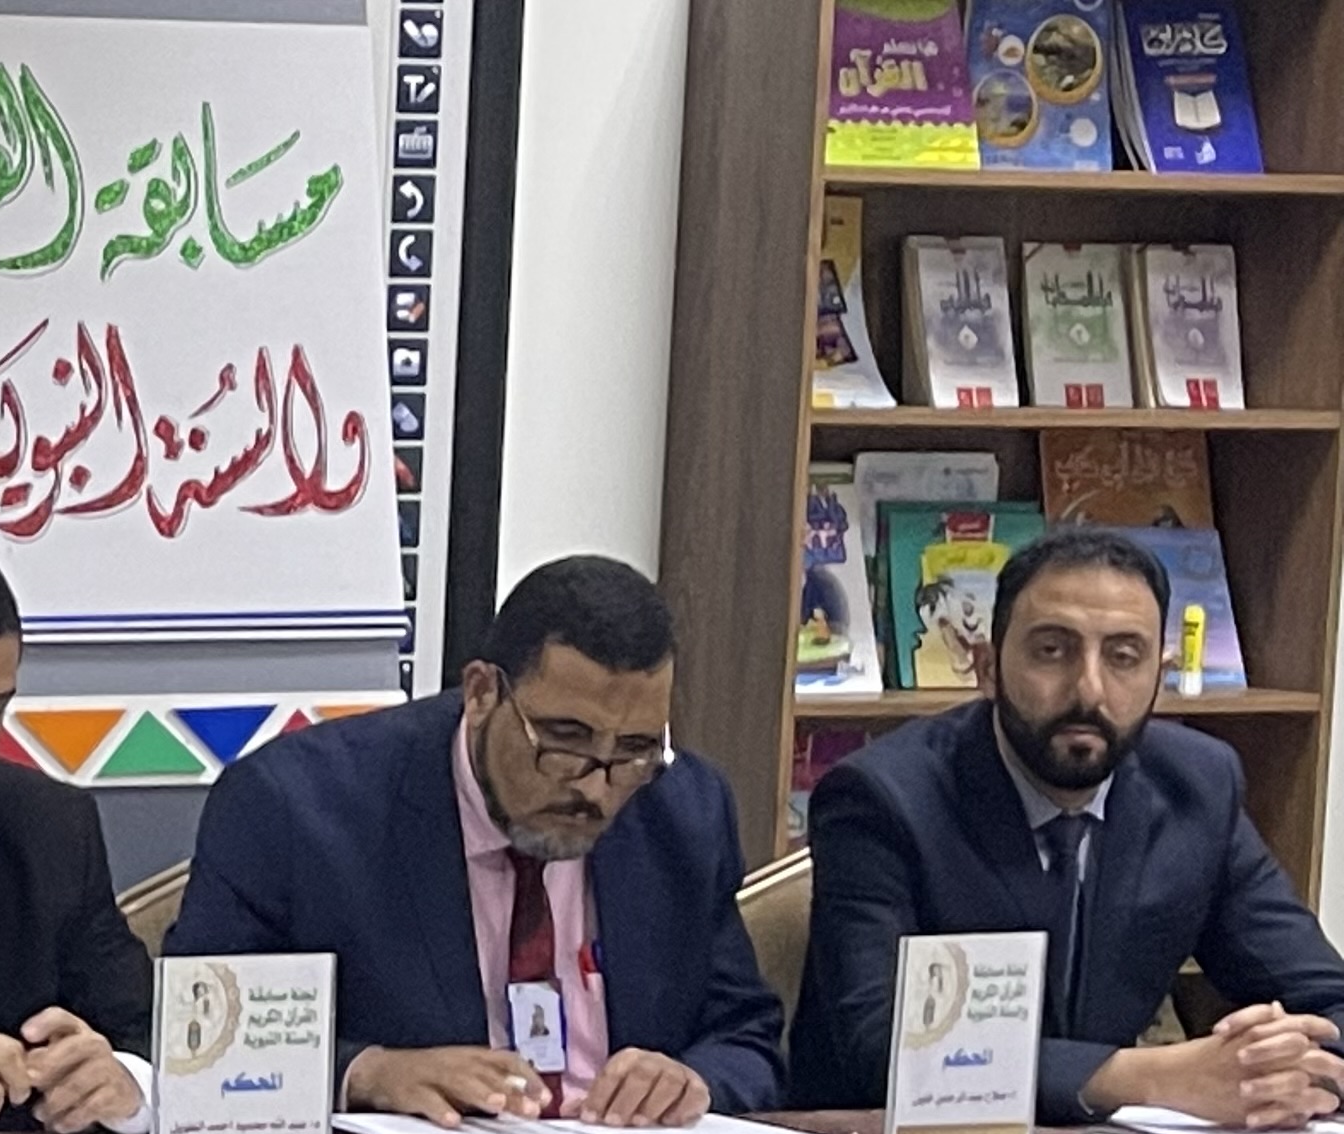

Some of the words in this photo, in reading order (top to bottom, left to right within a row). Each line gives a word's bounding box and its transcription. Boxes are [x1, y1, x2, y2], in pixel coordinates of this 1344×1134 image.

[94, 101, 342, 280] مسابقة
[942, 1048, 993, 1071] المحكم
[221, 1072, 283, 1099] المحكم
